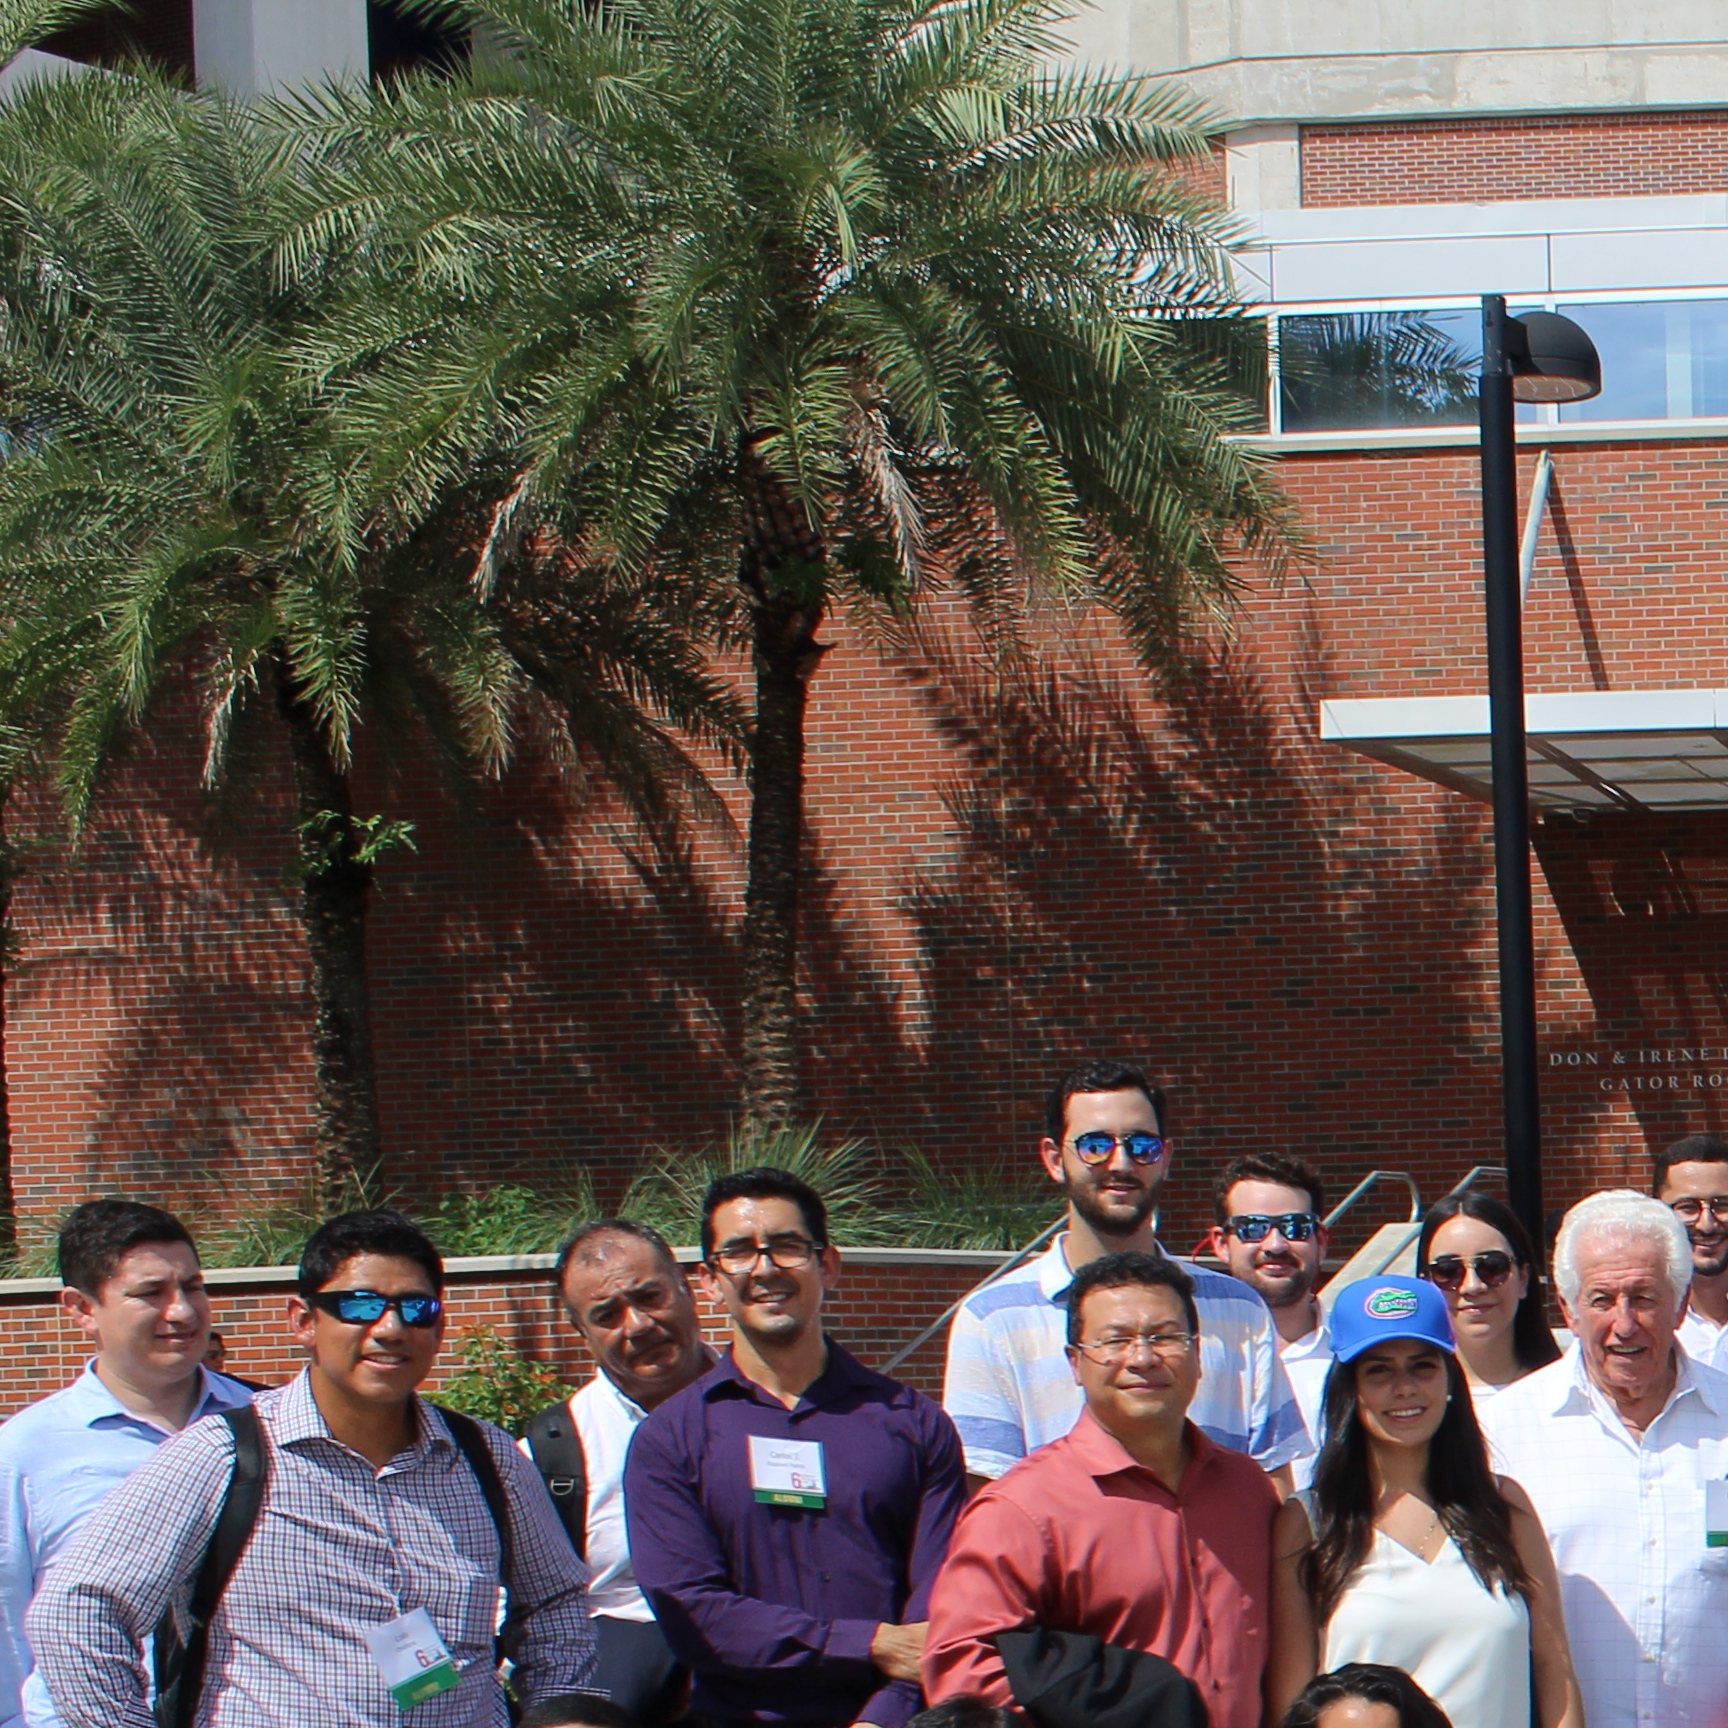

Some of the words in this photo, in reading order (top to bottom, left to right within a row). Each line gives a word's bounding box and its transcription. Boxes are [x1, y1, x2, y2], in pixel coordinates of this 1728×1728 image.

[1550, 1052, 1600, 1066] DON
[1613, 1052, 1626, 1064] &
[1639, 1048, 1709, 1063] IRENE
[1600, 1076, 1680, 1091] GATOR
